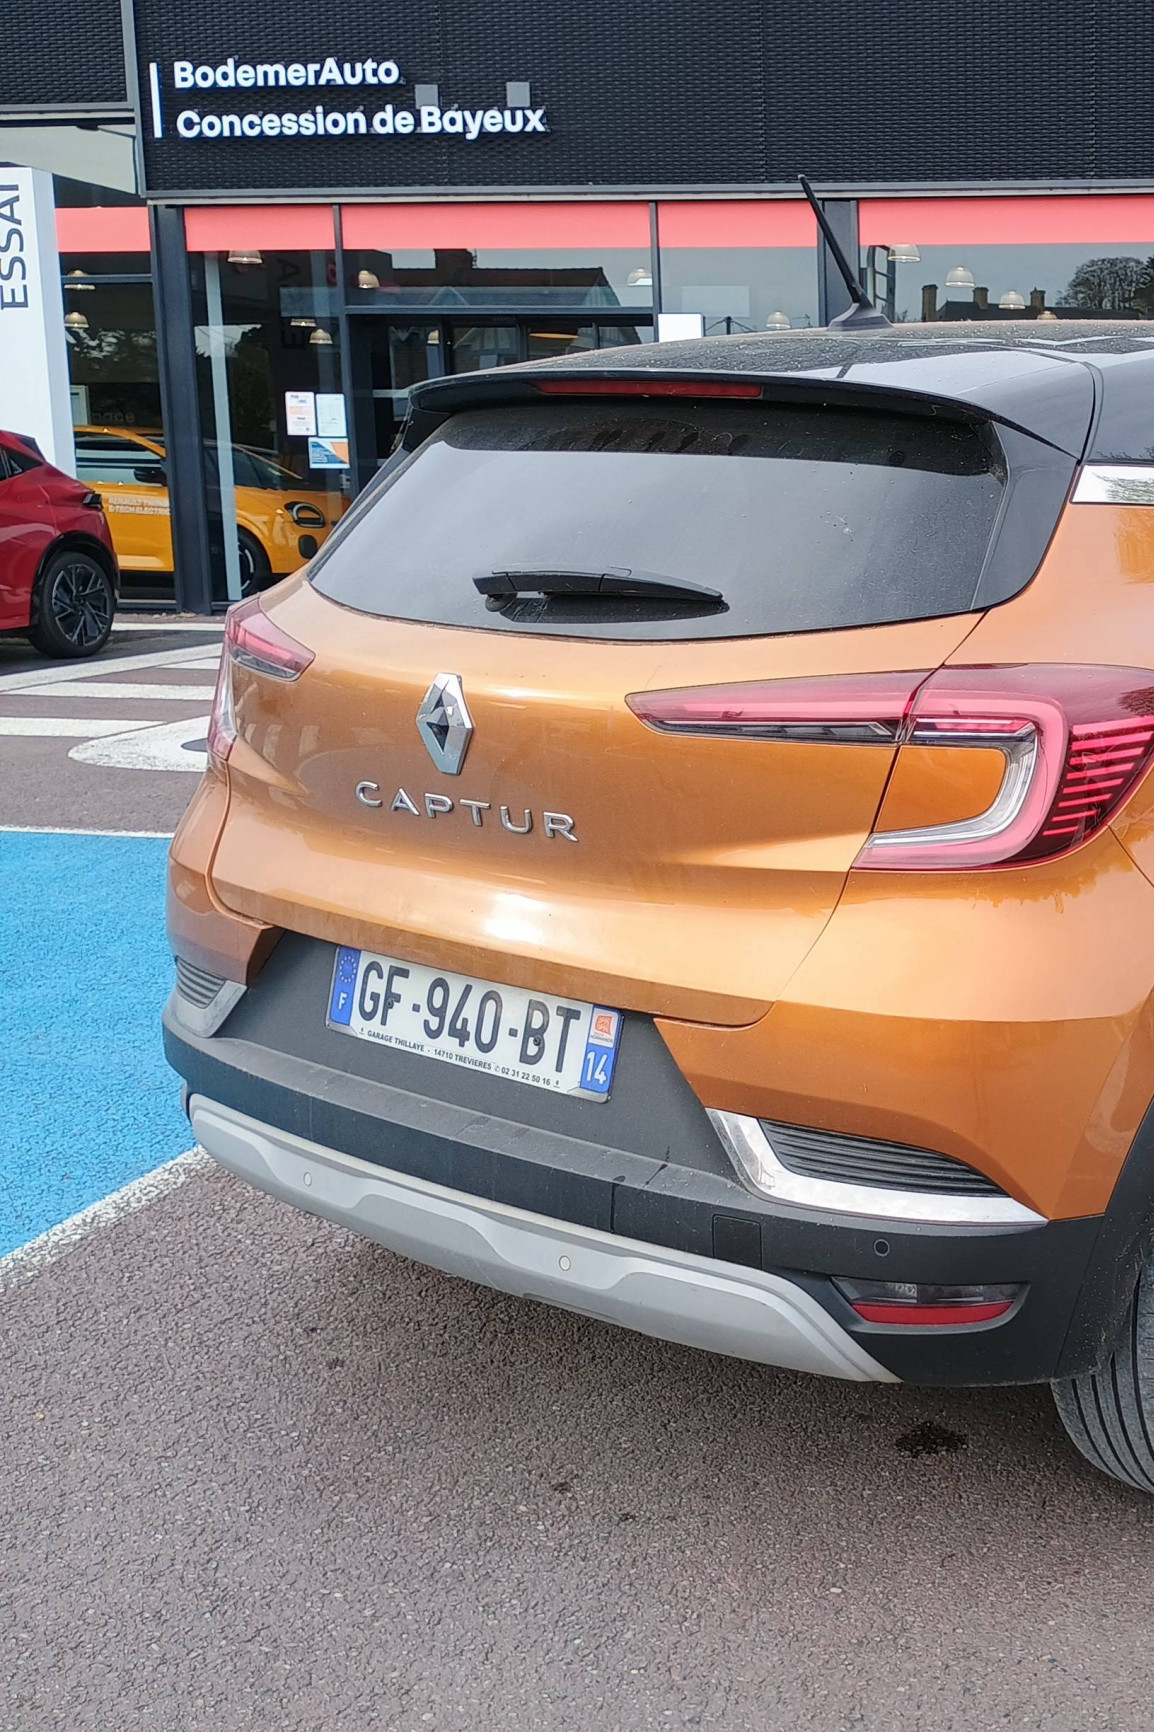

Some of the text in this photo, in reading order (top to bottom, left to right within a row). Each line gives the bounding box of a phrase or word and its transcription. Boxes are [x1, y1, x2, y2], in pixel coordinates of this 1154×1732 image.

[173, 57, 400, 89] BodemerAuto
[176, 104, 546, 141] Concession de Bayeux
[0, 184, 29, 310] ESSAI
[355, 781, 579, 843] CAPTUR
[338, 992, 349, 1010] F
[358, 961, 581, 1073] GF-940-BT
[367, 1030, 393, 1043] GARAGE
[395, 1038, 425, 1052] THILLAYE
[434, 1049, 454, 1060] 14710
[454, 1054, 492, 1070] TREVIERES
[501, 1067, 509, 1075] 02
[511, 1069, 520, 1077] 31
[521, 1072, 530, 1080] 22
[532, 1075, 540, 1083] 50
[586, 1051, 608, 1085] 14
